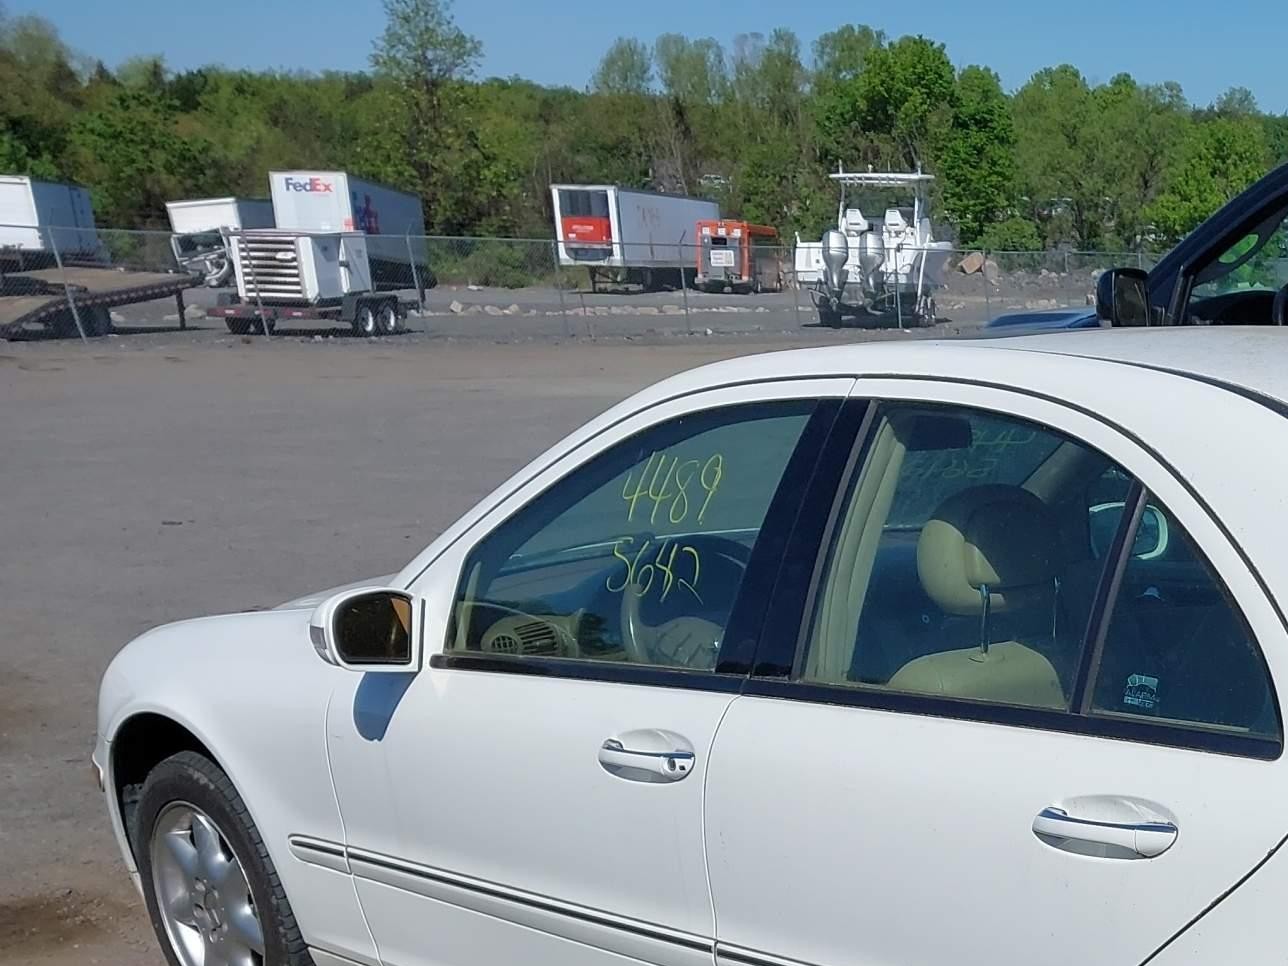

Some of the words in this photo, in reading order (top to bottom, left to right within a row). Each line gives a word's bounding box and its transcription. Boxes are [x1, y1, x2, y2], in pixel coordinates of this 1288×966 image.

[285, 177, 333, 192] FedEx
[623, 452, 723, 524] 4489
[606, 537, 704, 605] 5642
